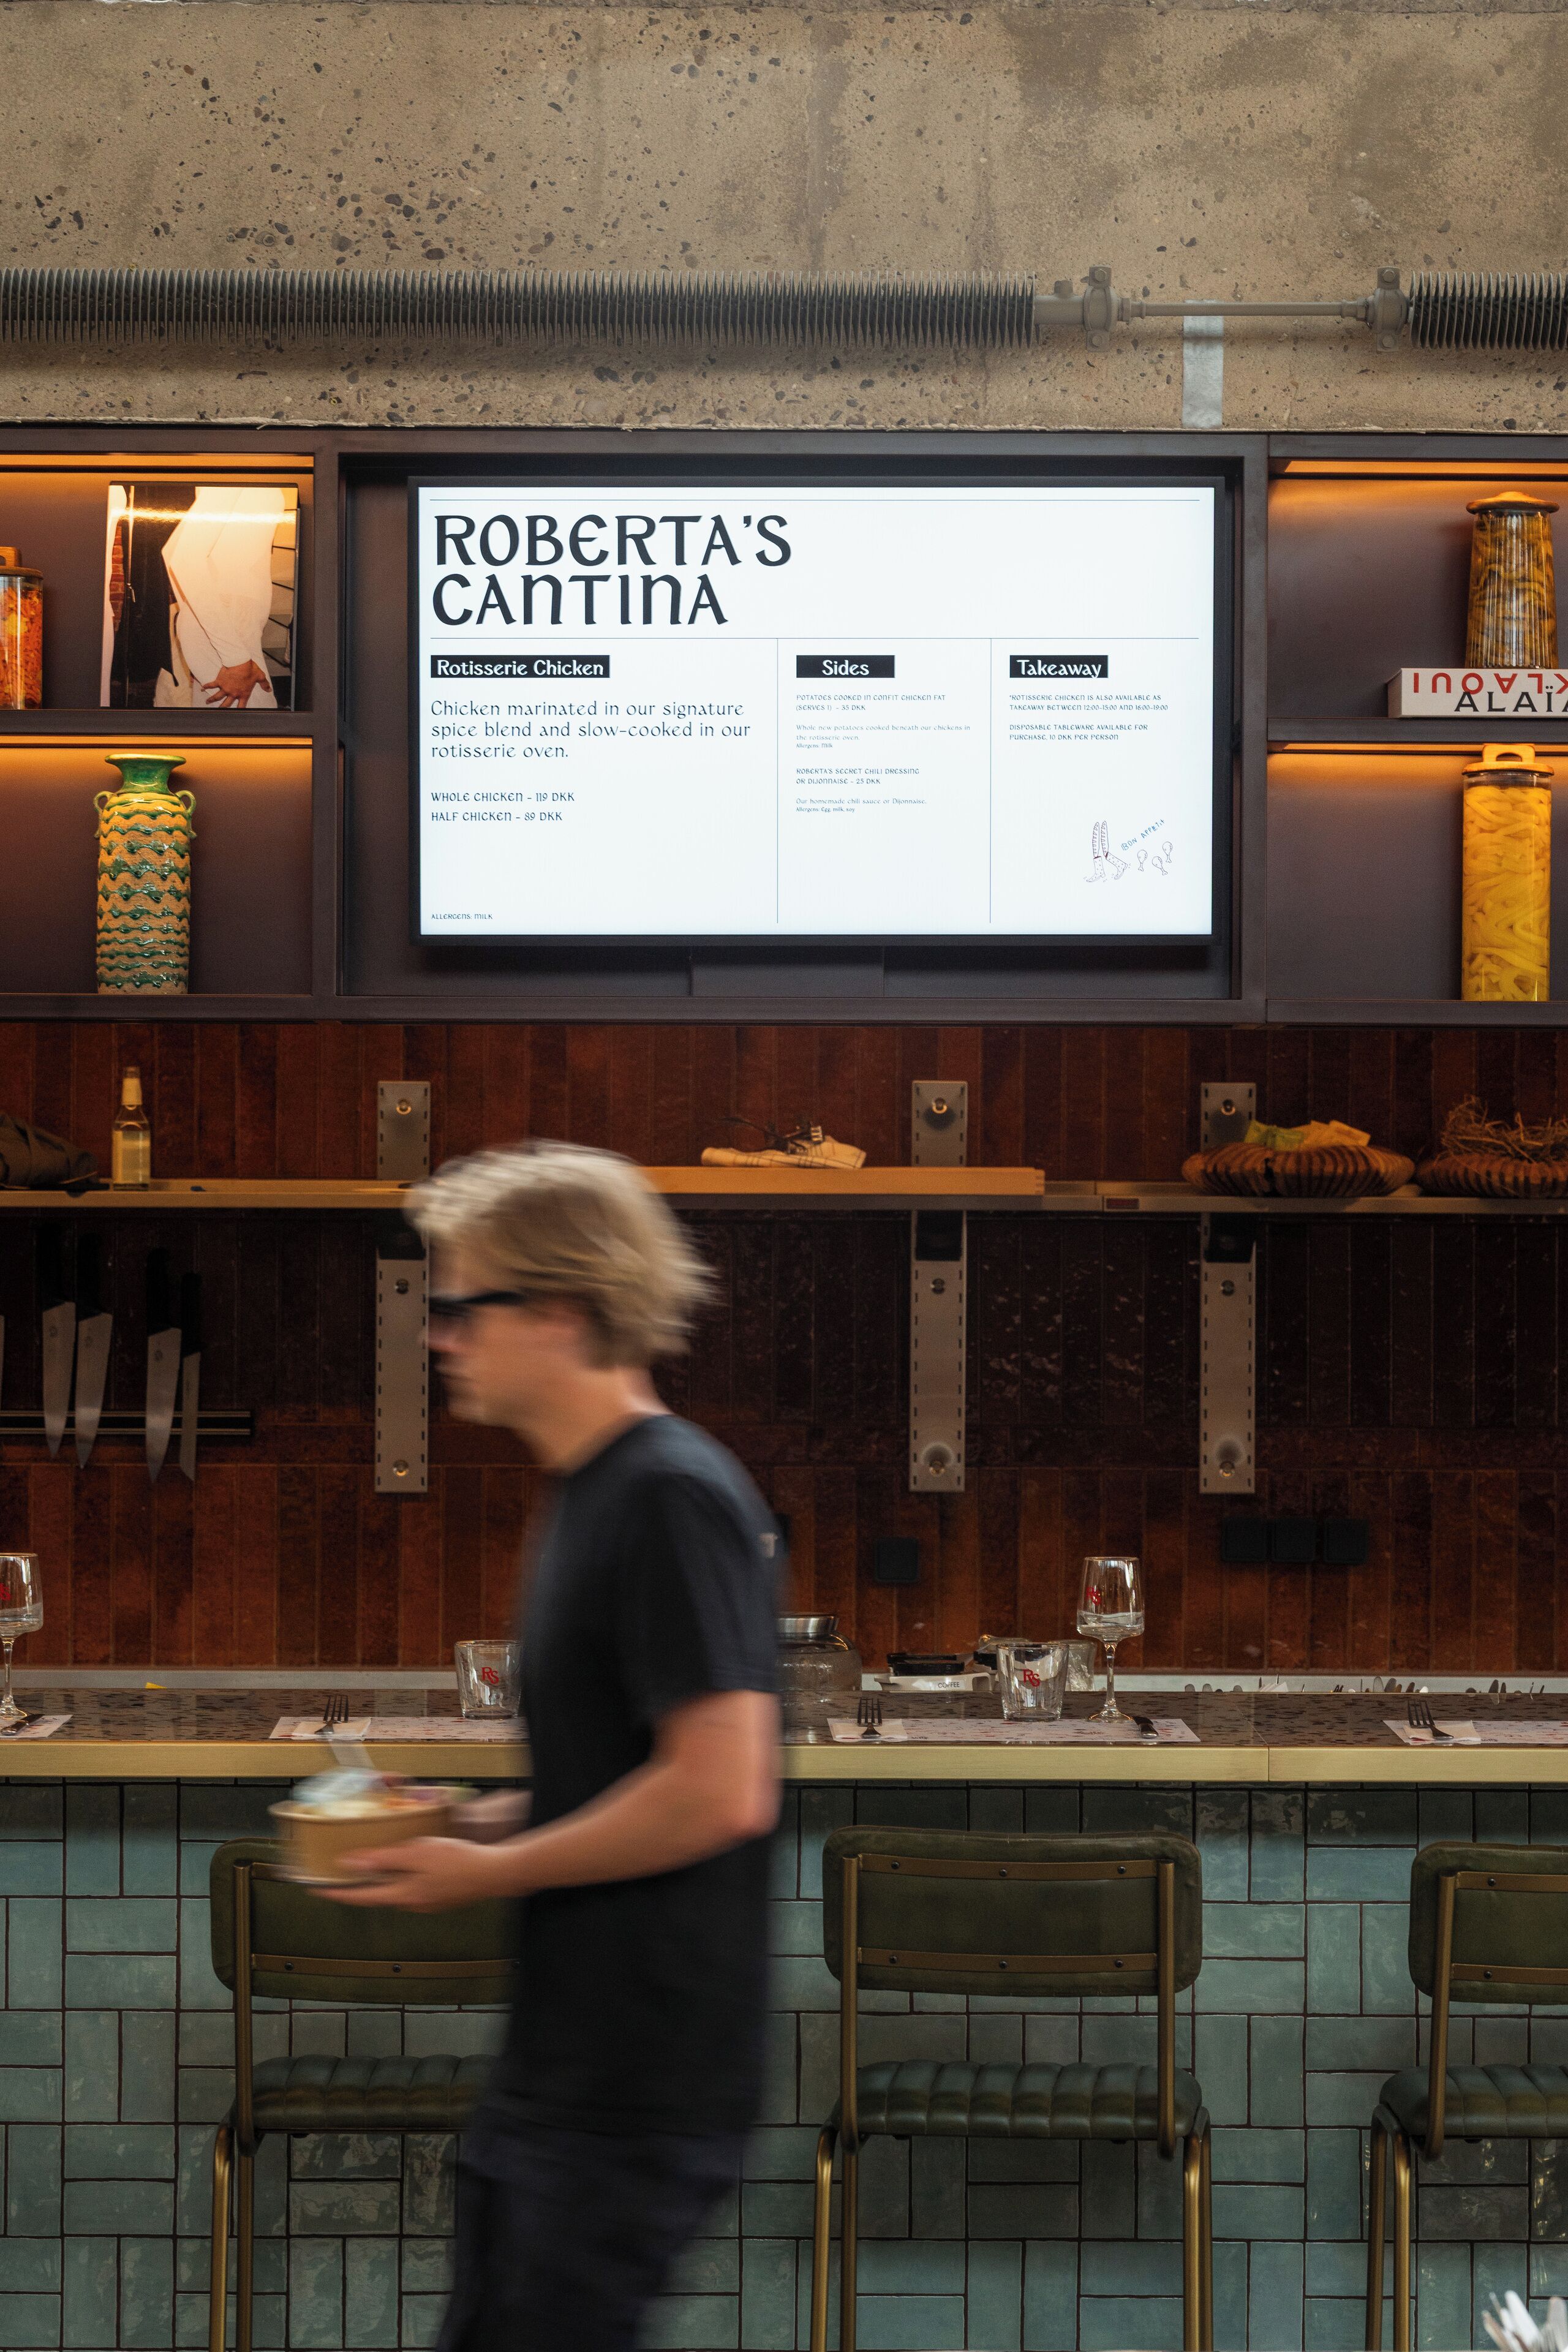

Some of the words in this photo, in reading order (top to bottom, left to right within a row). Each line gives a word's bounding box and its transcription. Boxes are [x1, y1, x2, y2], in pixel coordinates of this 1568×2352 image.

[434, 514, 791, 567] ROBERTA'S
[432, 573, 729, 626] CANTINA
[437, 659, 528, 676] Rotisserie
[533, 659, 604, 676] Chicken
[821, 659, 870, 676] Sides
[1017, 659, 1102, 679] Takeaway
[431, 700, 500, 716] Chicken
[508, 700, 597, 716] marinated
[605, 701, 619, 715] in
[626, 704, 656, 715] our
[662, 701, 744, 720] signature
[431, 722, 478, 741] spice
[484, 721, 532, 737] blend
[539, 721, 570, 737] and
[578, 721, 693, 737] slow-cooked
[700, 722, 714, 737] in
[722, 726, 751, 737] our
[431, 744, 516, 758] rotisserie
[523, 747, 568, 758] oven.
[431, 792, 470, 802] WHOLE
[473, 792, 523, 802] CHICKEN
[535, 793, 548, 802] 119
[552, 792, 575, 802] DKK
[431, 812, 459, 822] HALF
[462, 812, 512, 821] CHICKEN
[524, 812, 536, 821] 89
[539, 812, 563, 821] DKK
[481, 1667, 500, 1684] RS
[1023, 1668, 1041, 1687] RS
